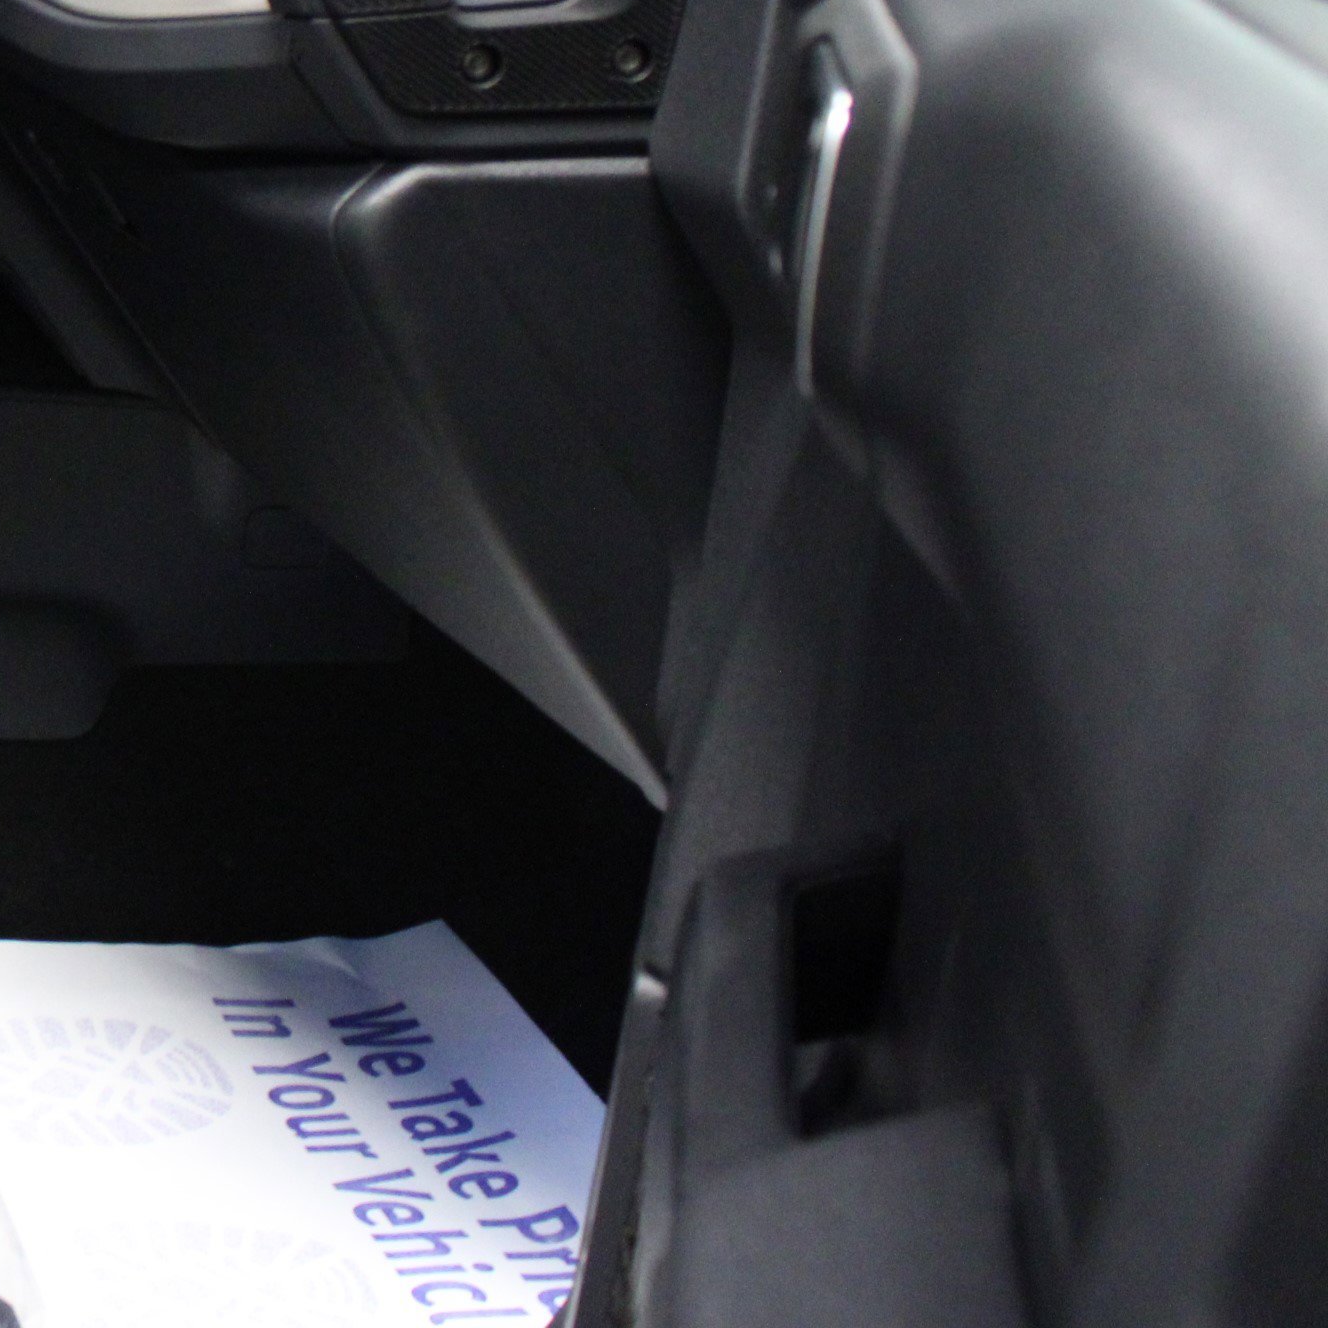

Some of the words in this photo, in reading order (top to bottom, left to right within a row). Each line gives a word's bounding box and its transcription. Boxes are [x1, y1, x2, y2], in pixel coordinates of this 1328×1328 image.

[212, 996, 297, 1038] In
[252, 1051, 379, 1159] Your
[328, 1001, 434, 1078] We
[387, 1078, 518, 1200] Take
